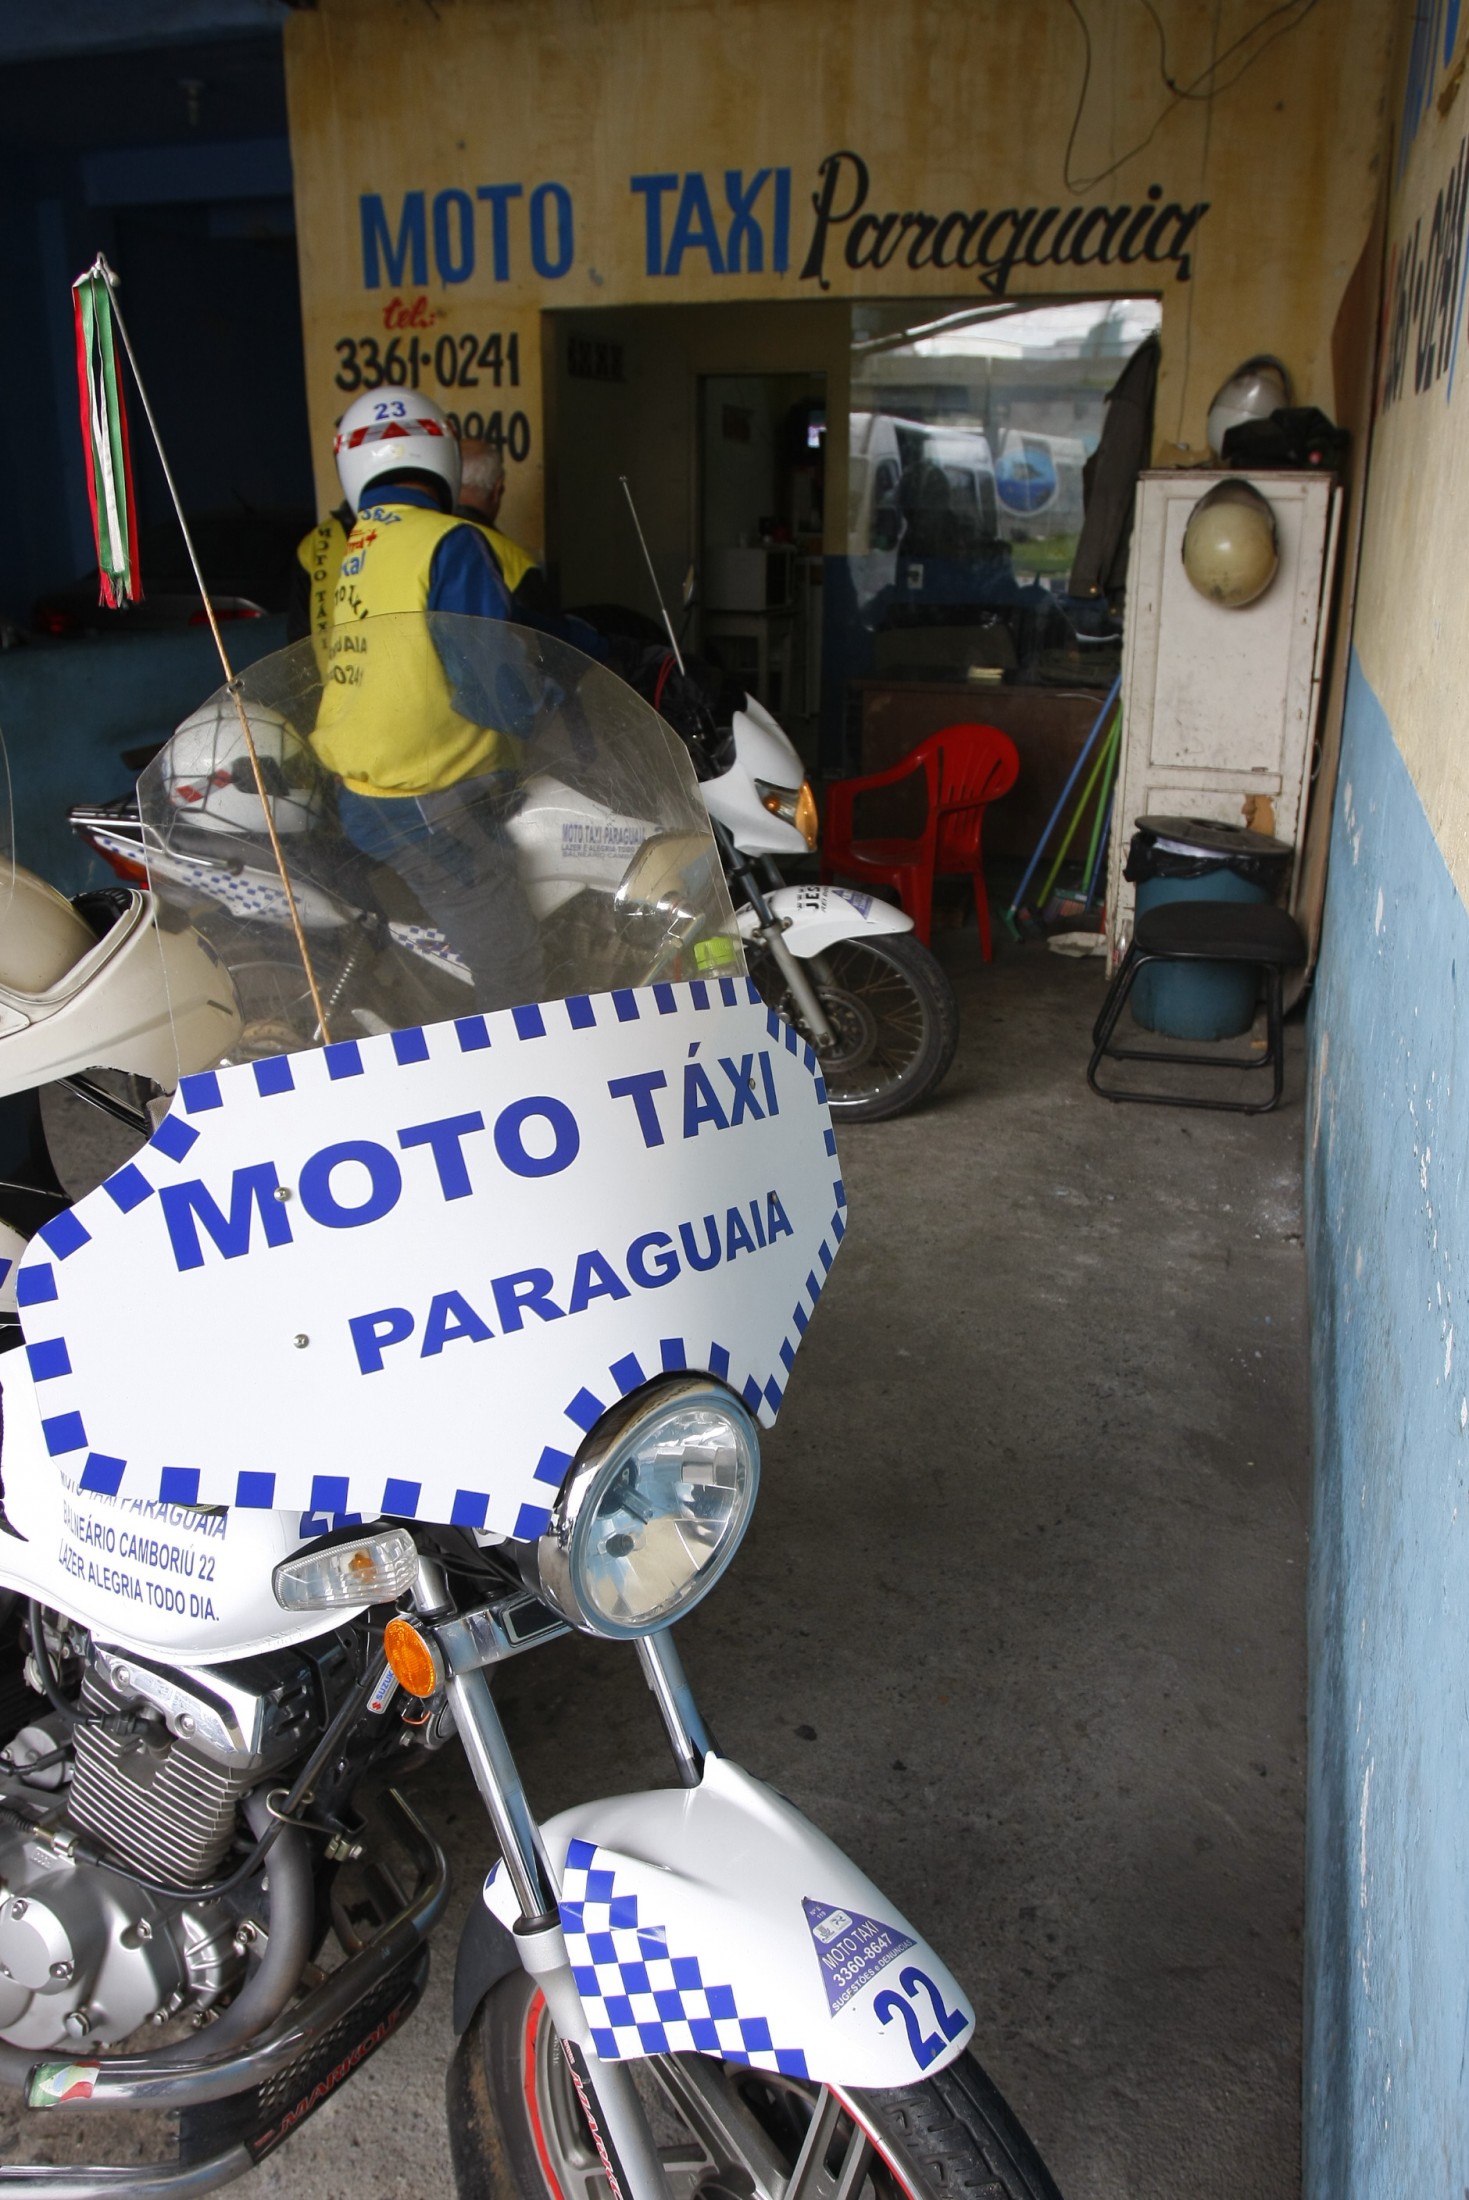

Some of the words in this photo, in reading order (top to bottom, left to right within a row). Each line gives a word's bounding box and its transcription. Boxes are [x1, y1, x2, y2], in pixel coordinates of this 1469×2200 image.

[359, 181, 575, 290] MOTO
[630, 166, 791, 278] TAXI
[800, 150, 1211, 296] Paraguaia
[374, 401, 406, 421] 23
[158, 1095, 580, 1273] MOTO
[606, 1042, 779, 1149] TÁXI
[348, 1190, 793, 1376] PARAGUAIA
[59, 1538, 86, 1581] LAZER
[88, 1561, 144, 1603] ALEGRIA
[146, 1581, 186, 1615] TODO
[190, 1593, 220, 1621] DIA.
[63, 1499, 116, 1554] BALNEÁRIO
[119, 1532, 195, 1577] CAMBORIÚ
[198, 1554, 216, 1582] 22
[376, 1670, 395, 1701] SUZUK
[821, 1937, 857, 1971] MOTO
[852, 1919, 880, 1945] TAXI
[833, 1932, 893, 1987] 3360-8647
[872, 1966, 970, 2071] 22
